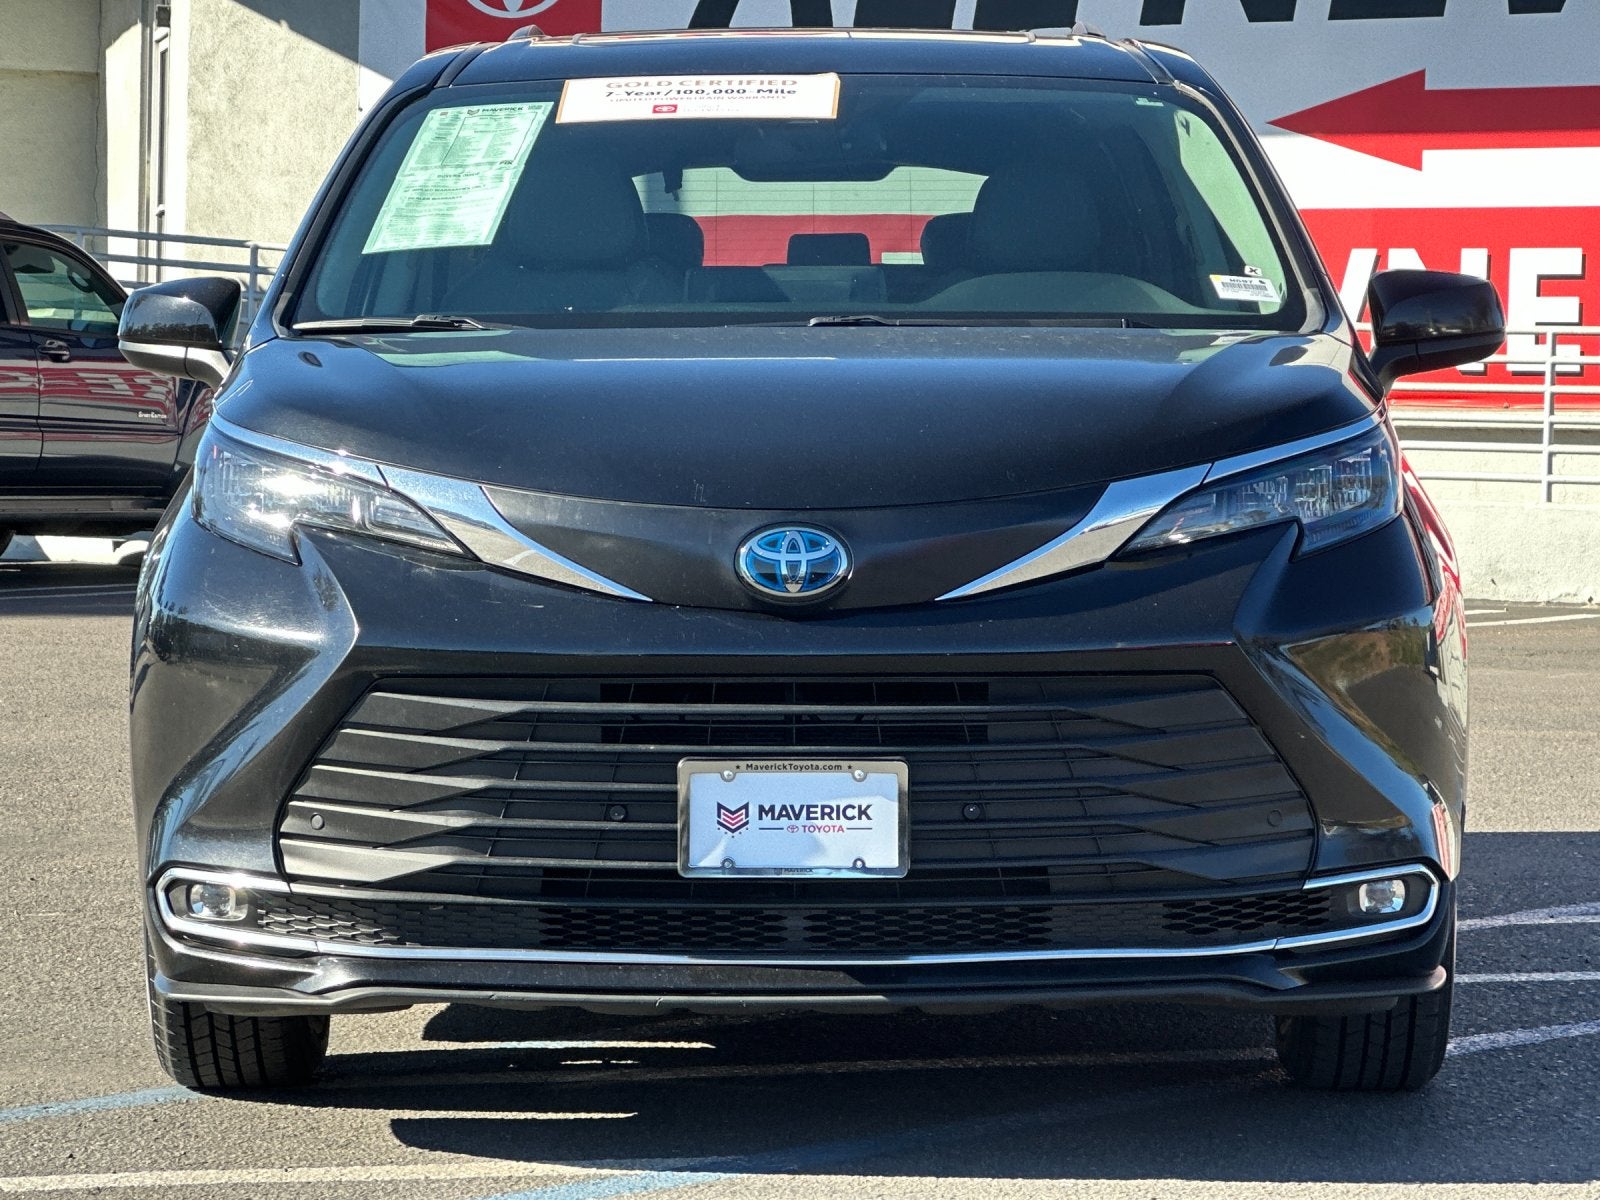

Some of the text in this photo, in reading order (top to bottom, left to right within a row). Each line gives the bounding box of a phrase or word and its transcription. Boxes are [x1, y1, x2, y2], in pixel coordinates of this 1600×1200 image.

[745, 763, 843, 772] MaverickToyota.com
[758, 804, 873, 821] MAVERICK
[802, 825, 845, 833] TOYOTA
